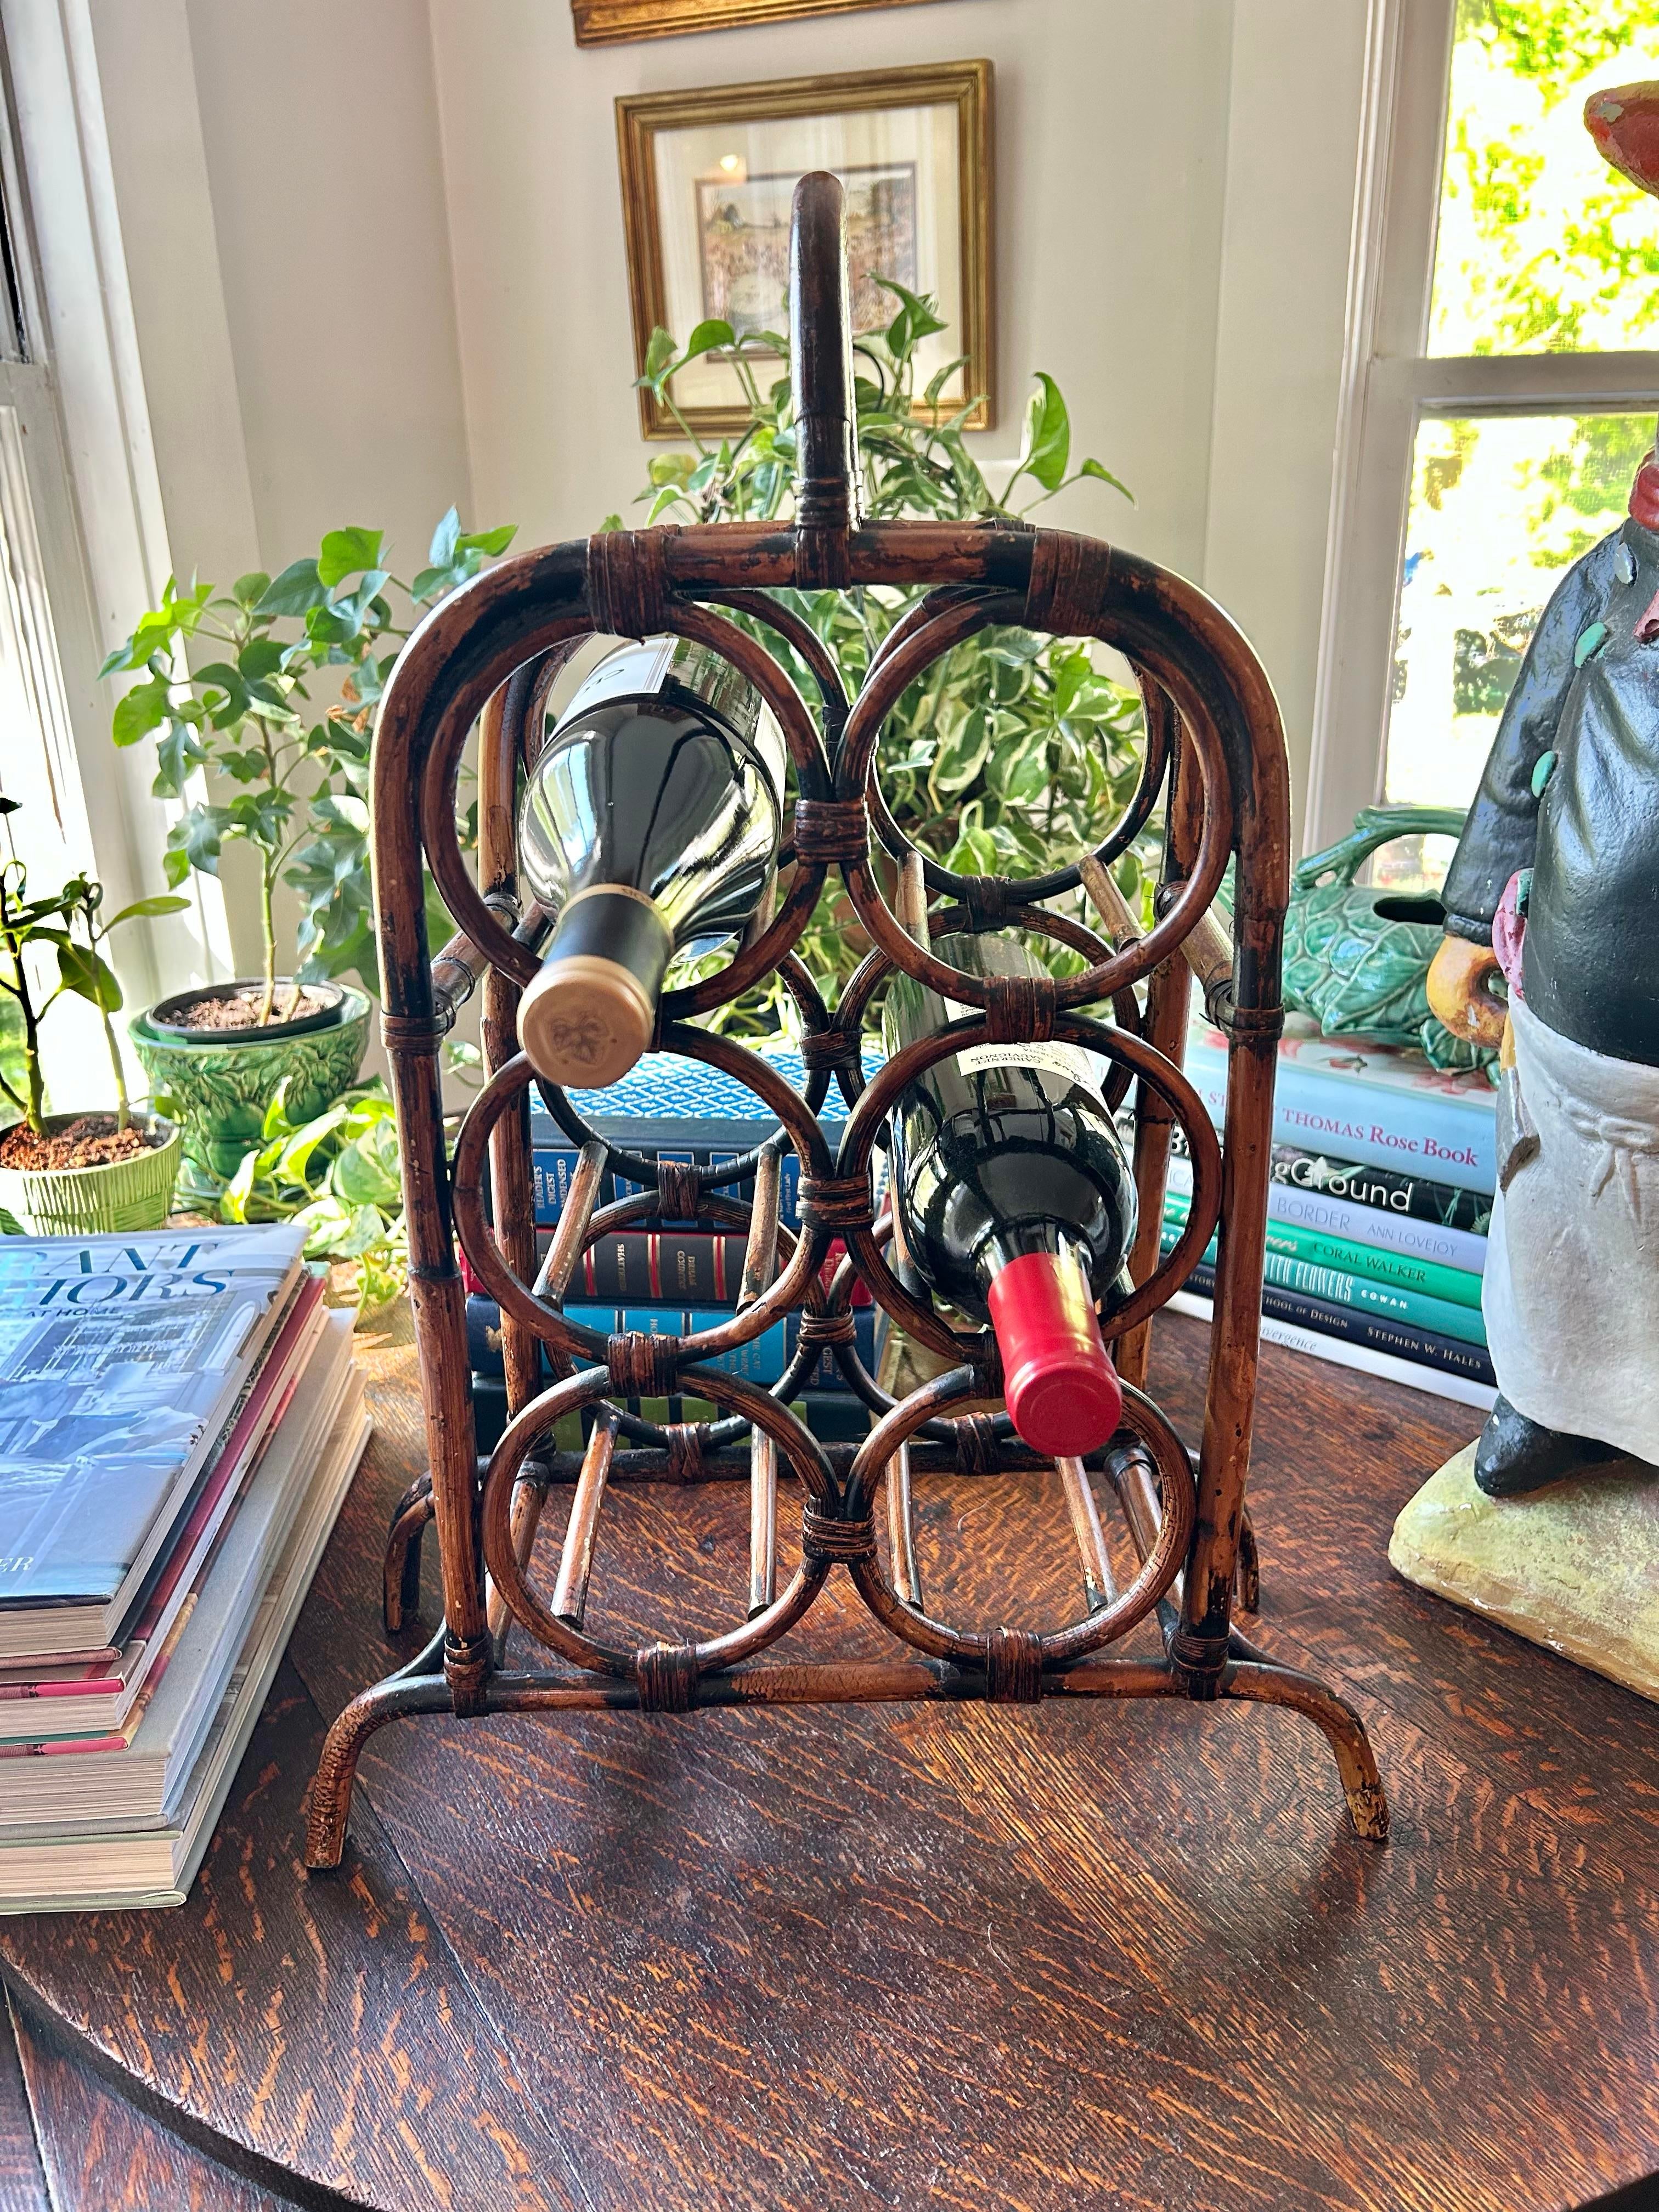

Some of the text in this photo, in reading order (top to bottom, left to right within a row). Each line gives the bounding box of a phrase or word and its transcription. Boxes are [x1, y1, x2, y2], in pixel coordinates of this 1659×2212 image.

[1282, 1108, 1480, 1167] THOMAS Rose Book
[534, 1166, 545, 1209] READER'S
[546, 1172, 556, 1205] DIGEST
[1277, 1197, 1458, 1256] BORDER ANN LOVEJOY
[1314, 1242, 1362, 1265] CORAL
[1366, 1256, 1427, 1282] WALKER
[1294, 1261, 1355, 1302] FLOWERS
[1361, 1289, 1408, 1310] COWAN
[56, 1306, 122, 1317] HOME
[1310, 1308, 1348, 1329] DESIGN
[1367, 1325, 1420, 1351] STEPHEN
[1443, 1348, 1481, 1369] HALES
